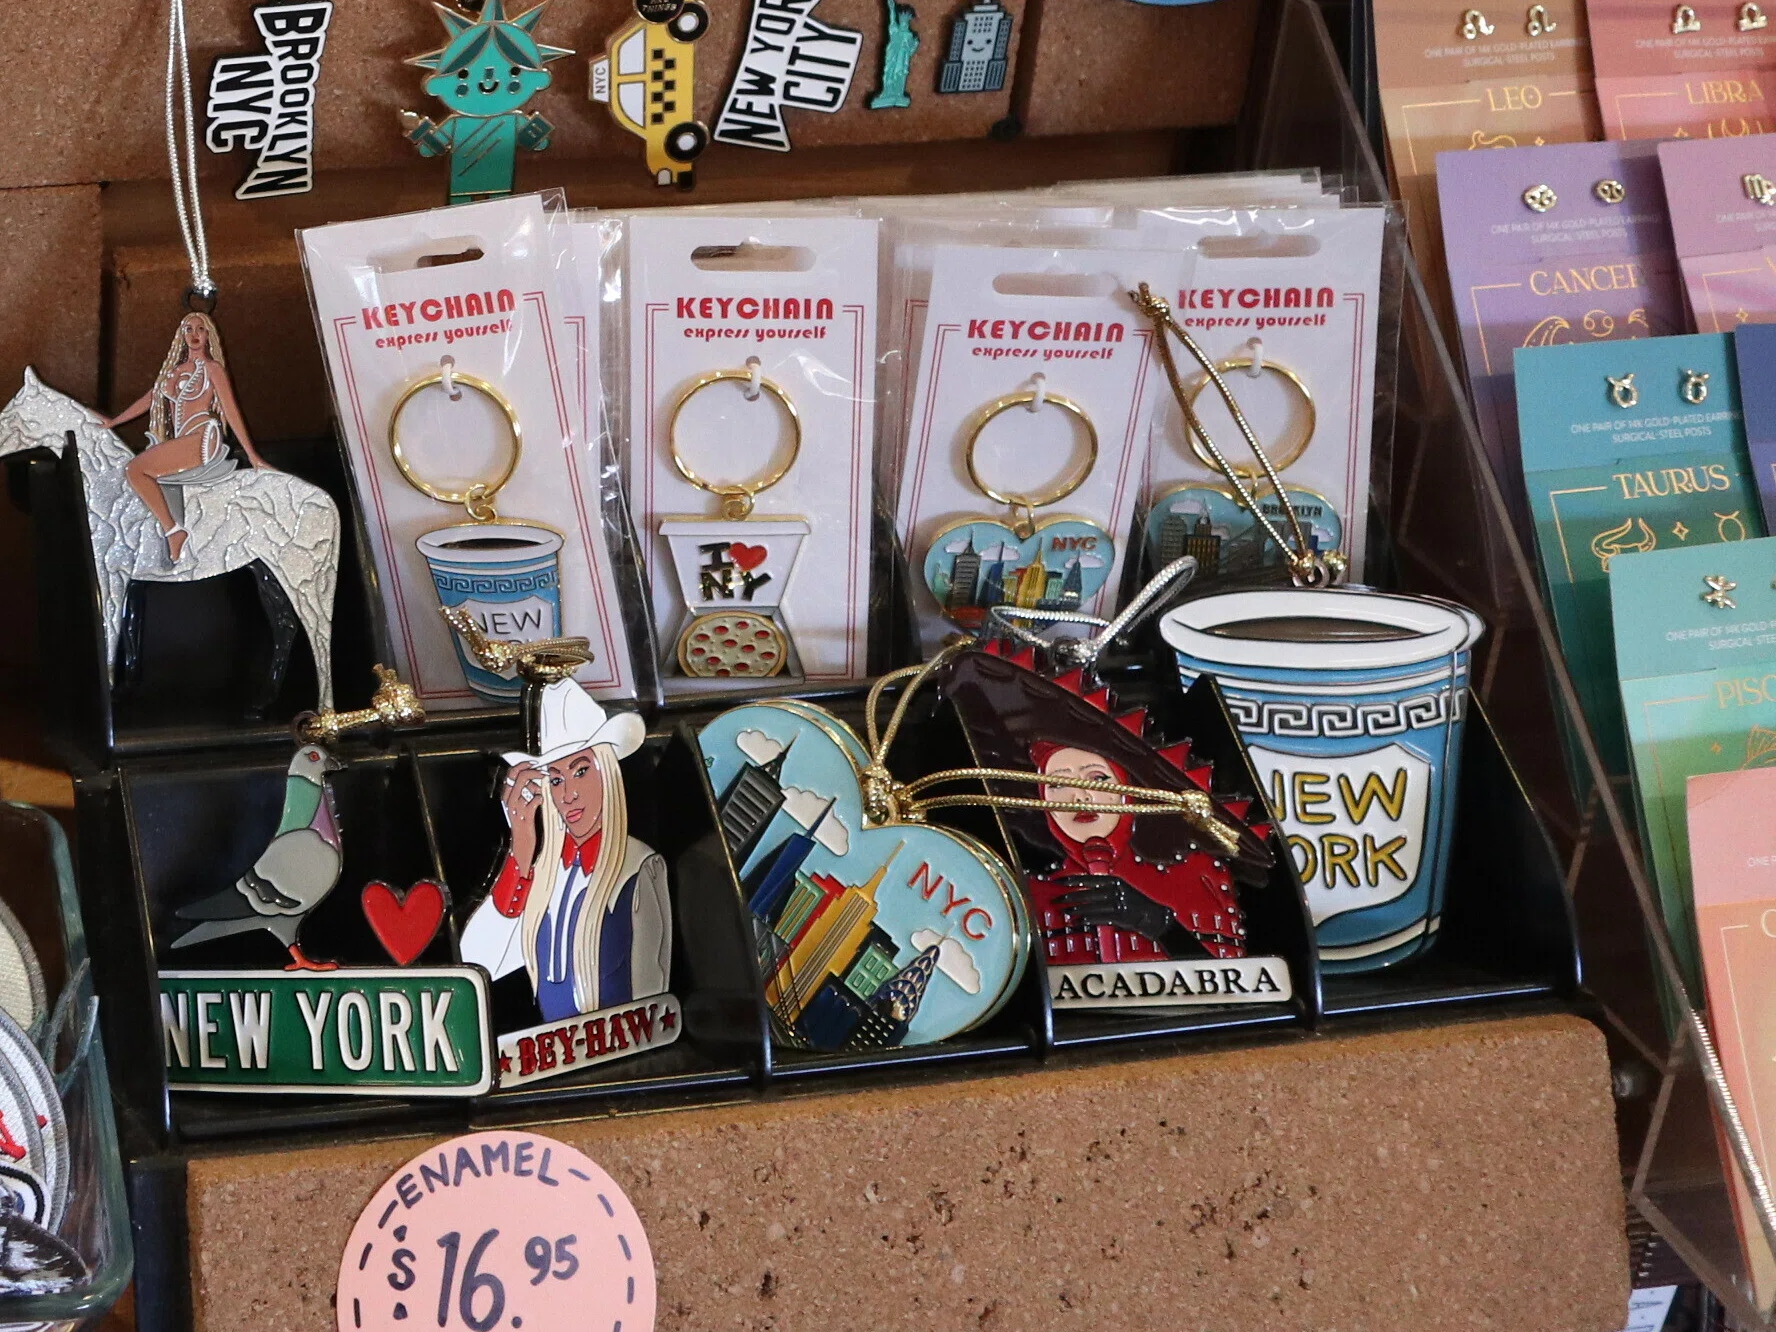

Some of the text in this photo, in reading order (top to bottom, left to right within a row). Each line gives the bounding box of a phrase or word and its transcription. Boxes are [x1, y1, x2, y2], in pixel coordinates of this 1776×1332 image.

[641, 3, 678, 14] THINGS
[782, 19, 860, 110] CITY
[595, 66, 607, 95] NYC
[1684, 79, 1765, 106] LIBRA
[209, 58, 273, 150] NYC
[240, 7, 328, 196] BROOKLYN
[717, 66, 788, 149] NEW
[1485, 83, 1542, 113] LEO
[361, 287, 517, 331] KEYCHAIN
[676, 296, 835, 321] KEYCHAIN
[1177, 286, 1337, 311] KEYCHAIN
[374, 320, 514, 351] express yourself
[683, 324, 828, 342] express yourself
[967, 318, 1126, 345] KEYCHAIN
[1184, 313, 1327, 331] express yourself
[972, 345, 1114, 363] express yourself
[1612, 464, 1732, 500] TAURUS
[696, 542, 732, 568] I
[1051, 534, 1098, 551] NYC
[699, 568, 772, 602] NY
[906, 860, 994, 943] NYC
[160, 989, 460, 1074] NEW YORK
[516, 1004, 661, 1078] BEY-HAW
[393, 1140, 560, 1209] ENAMEL
